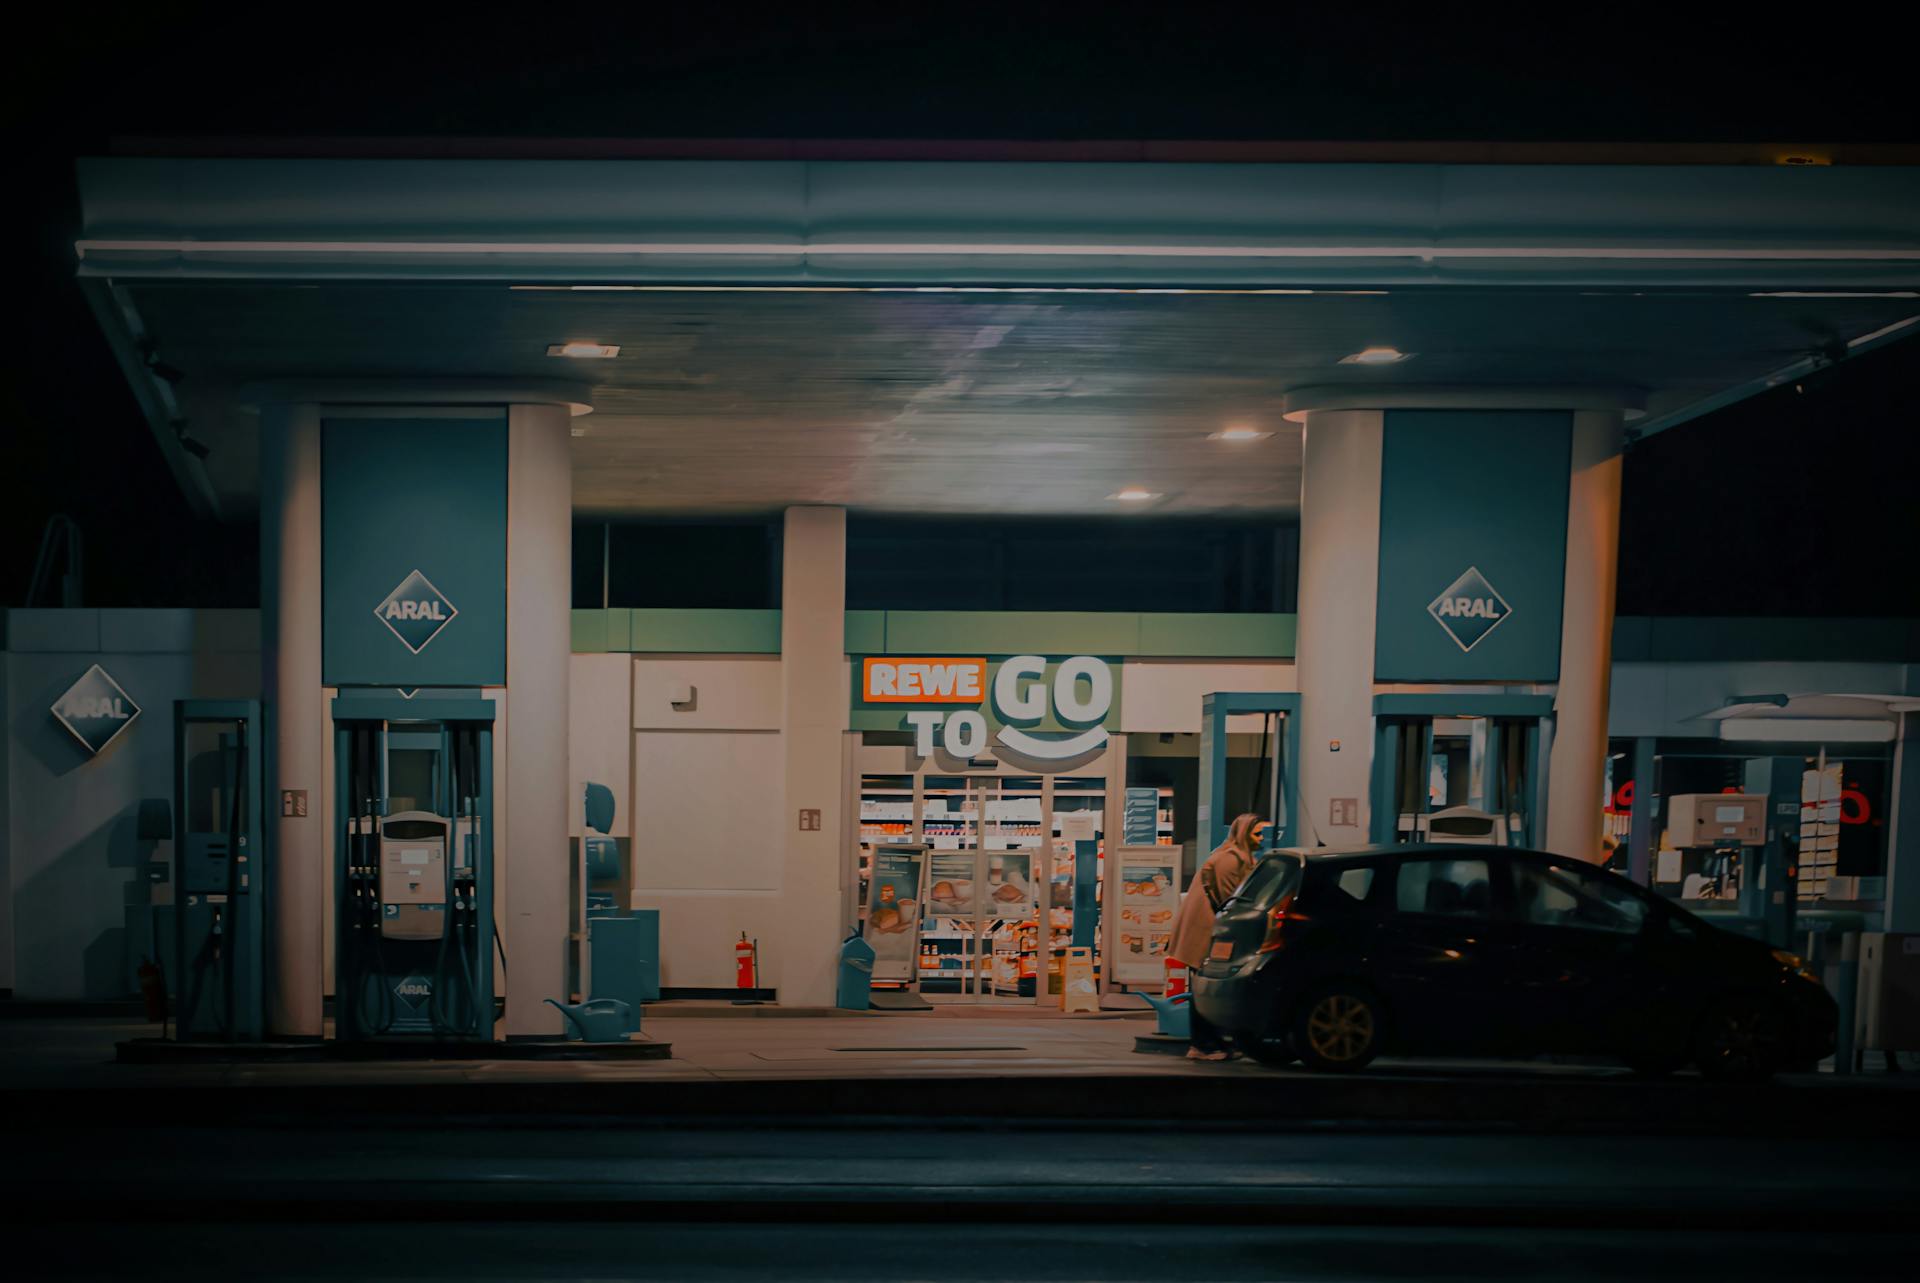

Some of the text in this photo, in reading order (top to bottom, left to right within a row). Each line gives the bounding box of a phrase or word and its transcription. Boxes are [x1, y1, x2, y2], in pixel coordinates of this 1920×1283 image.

[386, 600, 446, 620] ARAL
[1438, 598, 1500, 618] ARAL
[869, 663, 981, 696] REWE
[63, 697, 129, 719] ARAL
[907, 655, 1113, 758] TO GO
[400, 984, 432, 996] ARAL
